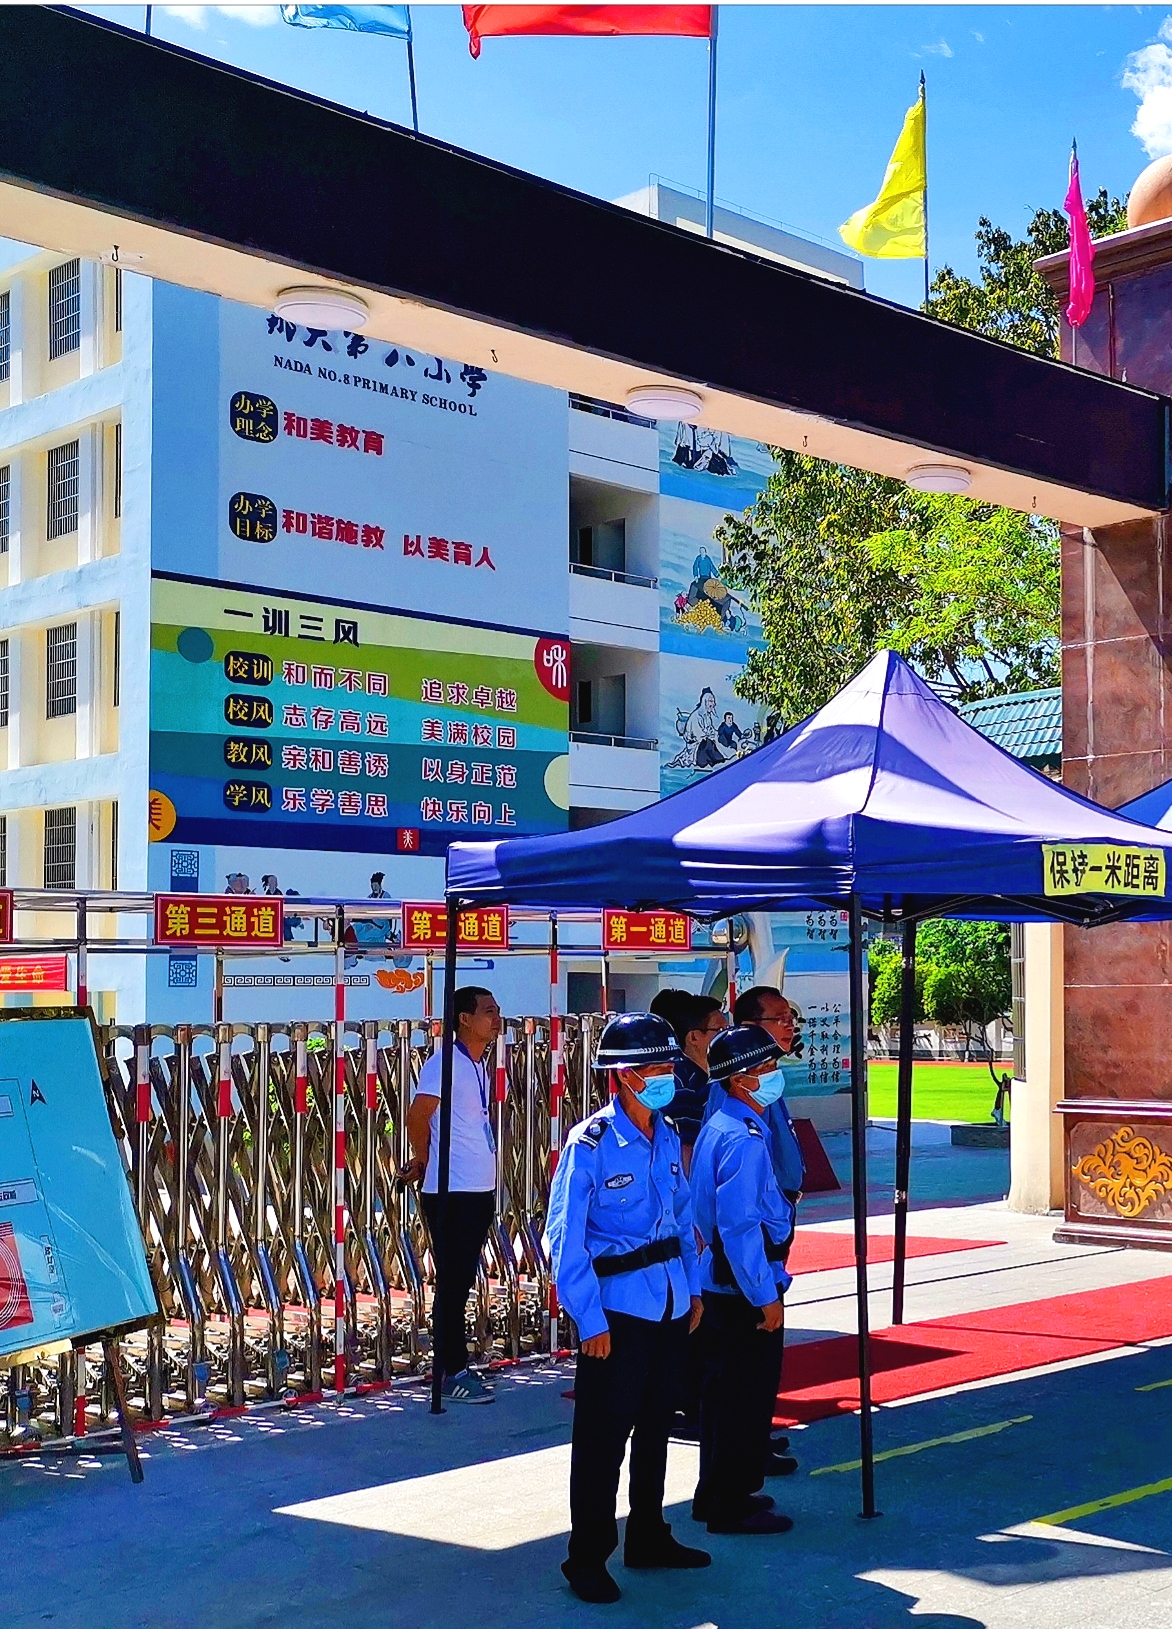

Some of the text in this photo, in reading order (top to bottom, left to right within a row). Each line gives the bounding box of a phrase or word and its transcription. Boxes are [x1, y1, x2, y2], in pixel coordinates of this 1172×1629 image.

[274, 355, 313, 375] NADA
[353, 375, 418, 402] PRIMARY
[421, 393, 478, 416] SCHOOL
[282, 410, 385, 456] 和美教育
[281, 508, 497, 571] 和谐施教 以美育人
[223, 606, 360, 647] 一训三风
[226, 654, 518, 713] 校训 和而不同 追求卓越
[226, 696, 518, 750] 校风 志存高远 美满校园
[226, 740, 518, 790] 教风 亲和善诱 以身正范
[225, 784, 517, 827] 学风 乐学善思 快乐向上
[1050, 849, 1160, 891] 保持一米距离
[165, 903, 275, 937] 第三通道
[411, 910, 502, 941] 第二通道
[609, 915, 686, 944] 第一通道
